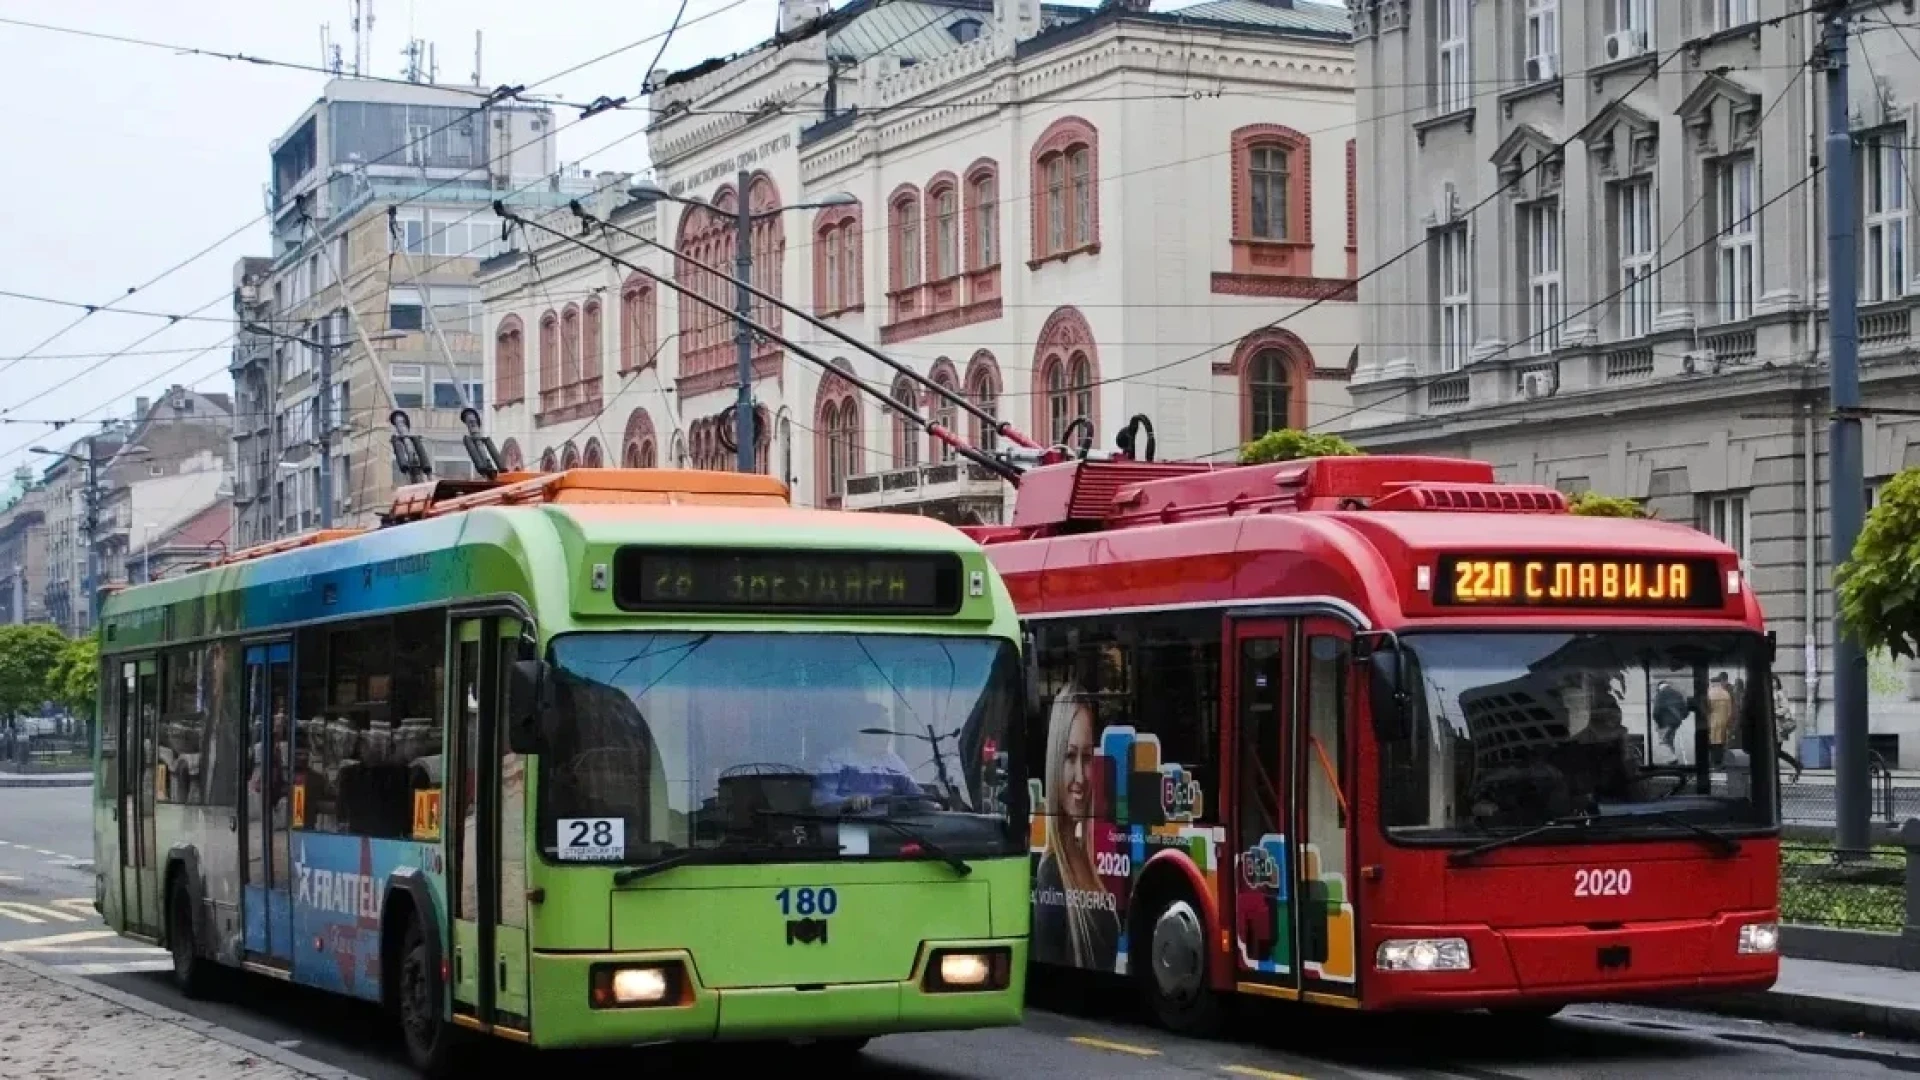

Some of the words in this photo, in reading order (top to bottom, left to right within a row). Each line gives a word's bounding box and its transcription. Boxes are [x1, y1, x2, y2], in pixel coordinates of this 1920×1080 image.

[1455, 561, 1511, 599] 22Л
[1525, 562, 1689, 599] СЛАВИЈА
[569, 820, 613, 847] 28
[1096, 852, 1130, 877] 2020
[1574, 868, 1632, 897] 2020
[775, 887, 838, 916] 180
